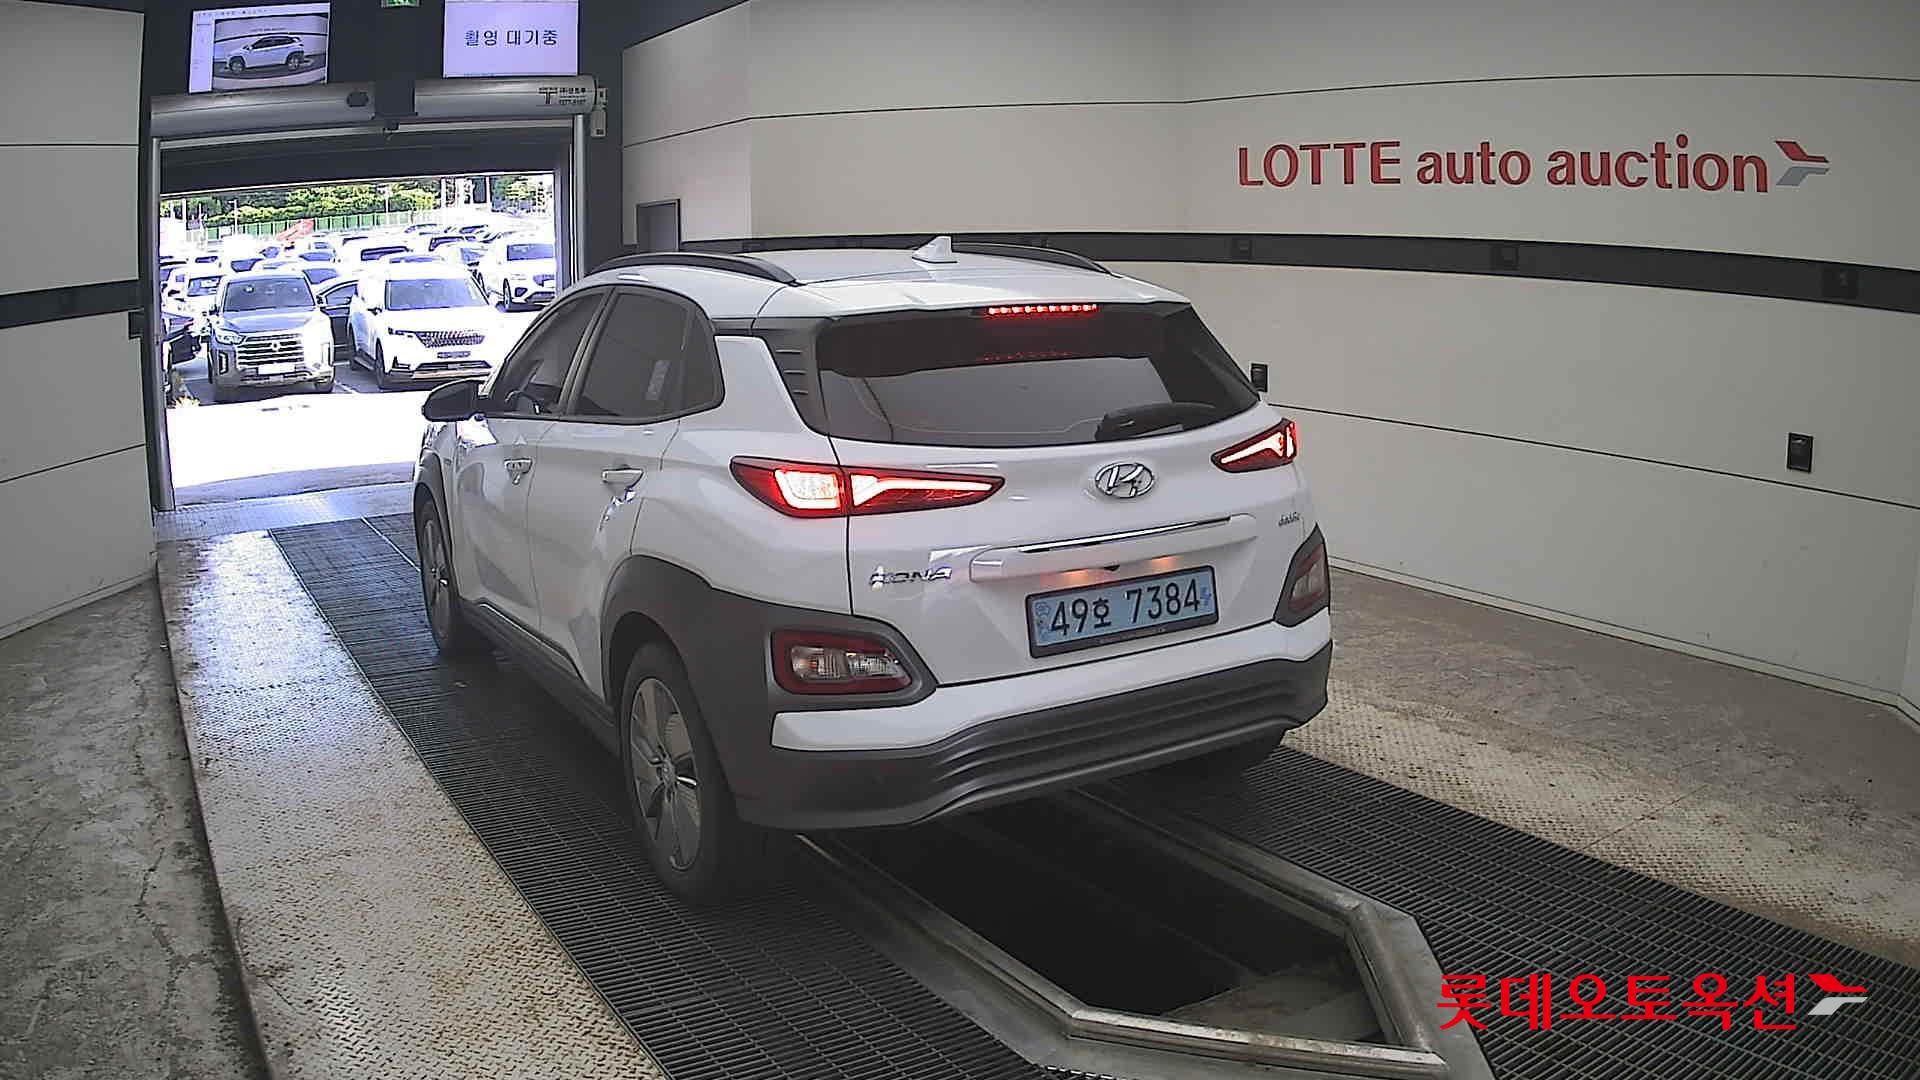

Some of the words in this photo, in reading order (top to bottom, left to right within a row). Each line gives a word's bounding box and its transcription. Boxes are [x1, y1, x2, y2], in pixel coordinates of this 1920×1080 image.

[506, 29, 558, 46] 대기중
[1239, 142, 1400, 187] LOTTE
[1417, 142, 1531, 185] auto
[1547, 135, 1768, 192] auction
[1050, 598, 1112, 636] 49호
[1125, 578, 1201, 625] 7384
